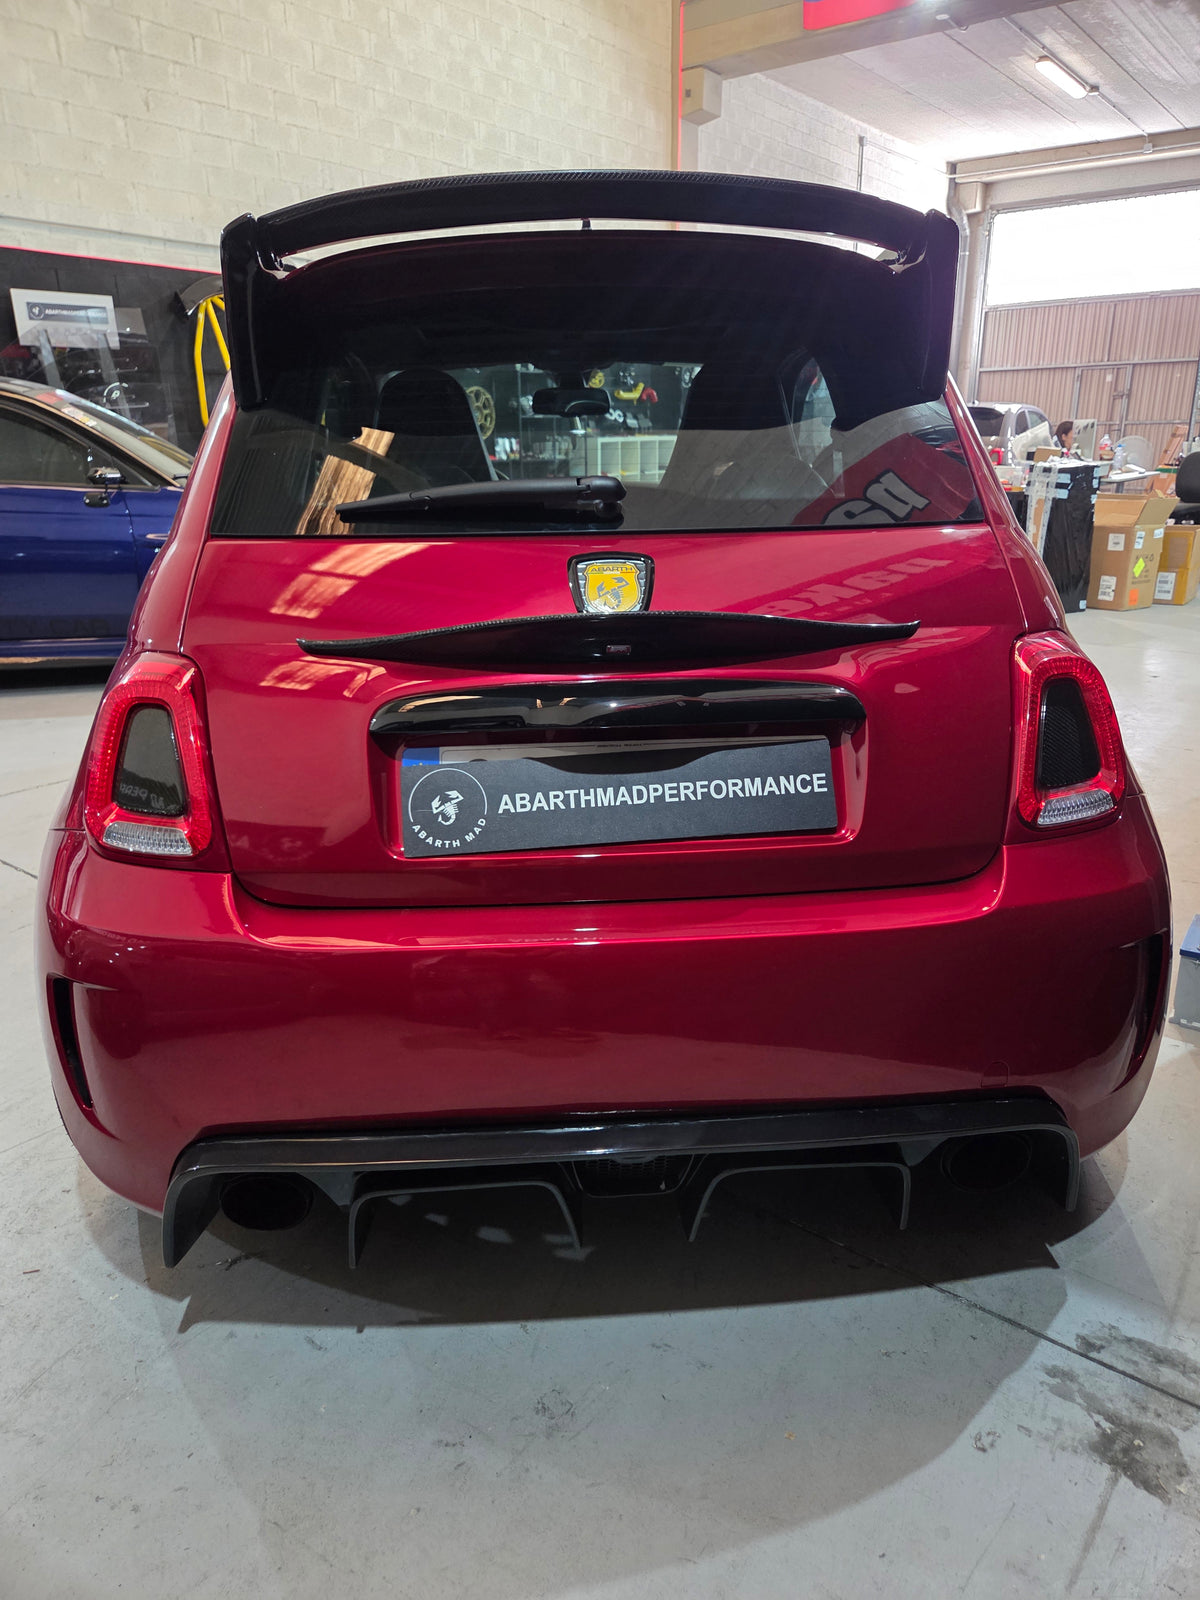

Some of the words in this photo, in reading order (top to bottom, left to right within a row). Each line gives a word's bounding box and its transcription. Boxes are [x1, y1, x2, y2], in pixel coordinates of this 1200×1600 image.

[498, 773, 828, 814] ABARTHMADPERFORMANCE
[412, 824, 461, 849] ABARTH
[464, 818, 486, 842] MAD
